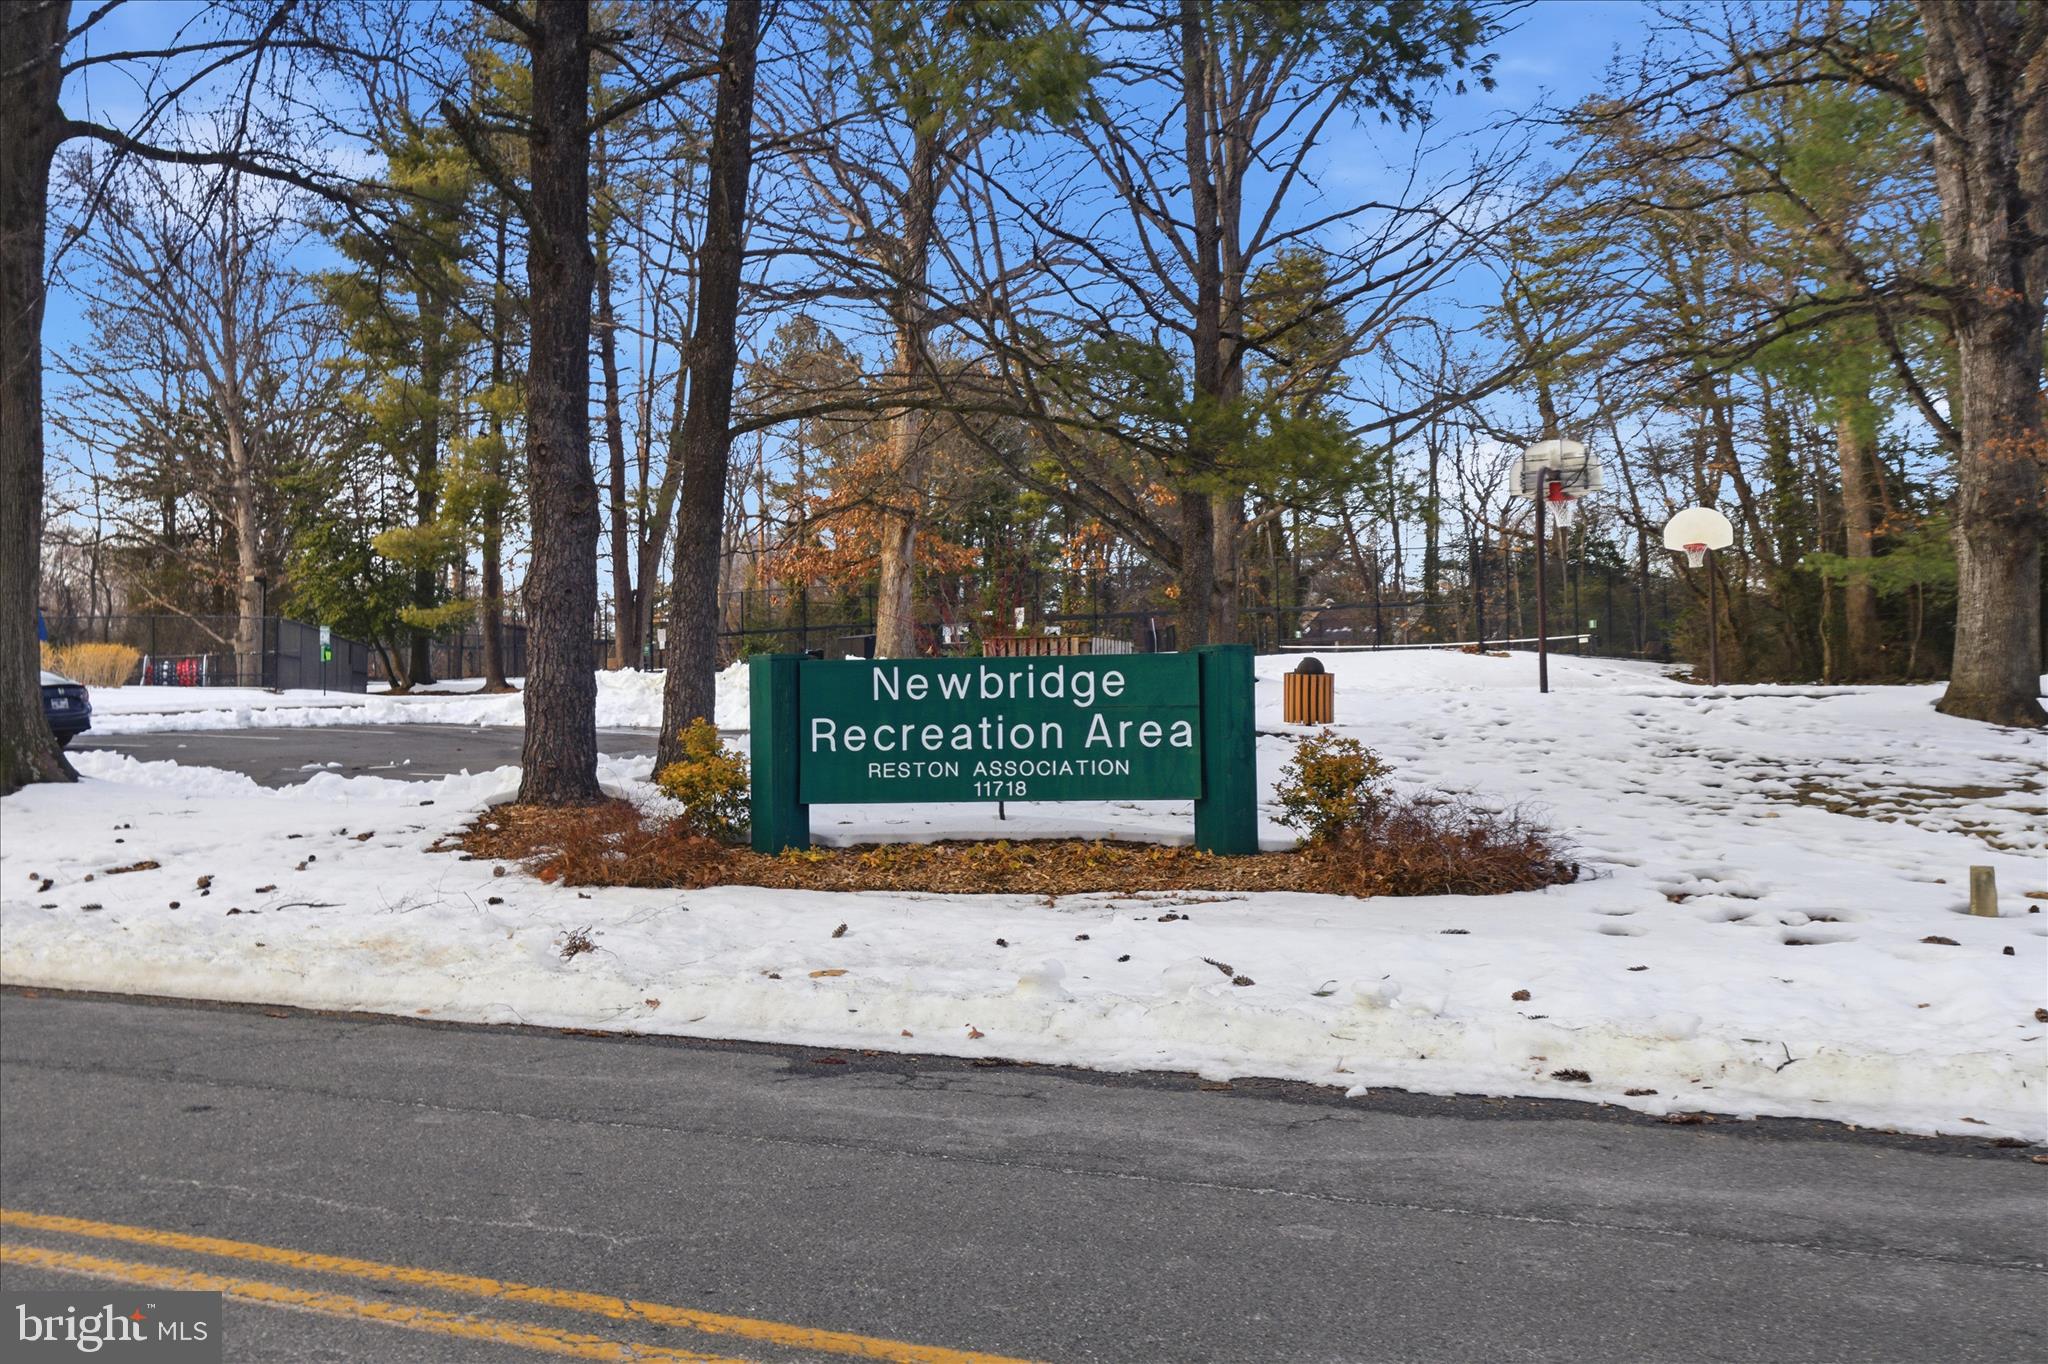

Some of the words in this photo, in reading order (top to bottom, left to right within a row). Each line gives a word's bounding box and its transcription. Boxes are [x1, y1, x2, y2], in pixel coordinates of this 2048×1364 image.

[873, 664, 1126, 708] Newbridge
[811, 714, 1063, 753] Recreation
[1084, 713, 1194, 748] Area
[868, 761, 959, 778] RESTON
[973, 759, 1130, 777] ASSOCIATION
[974, 780, 1027, 797] 11718
